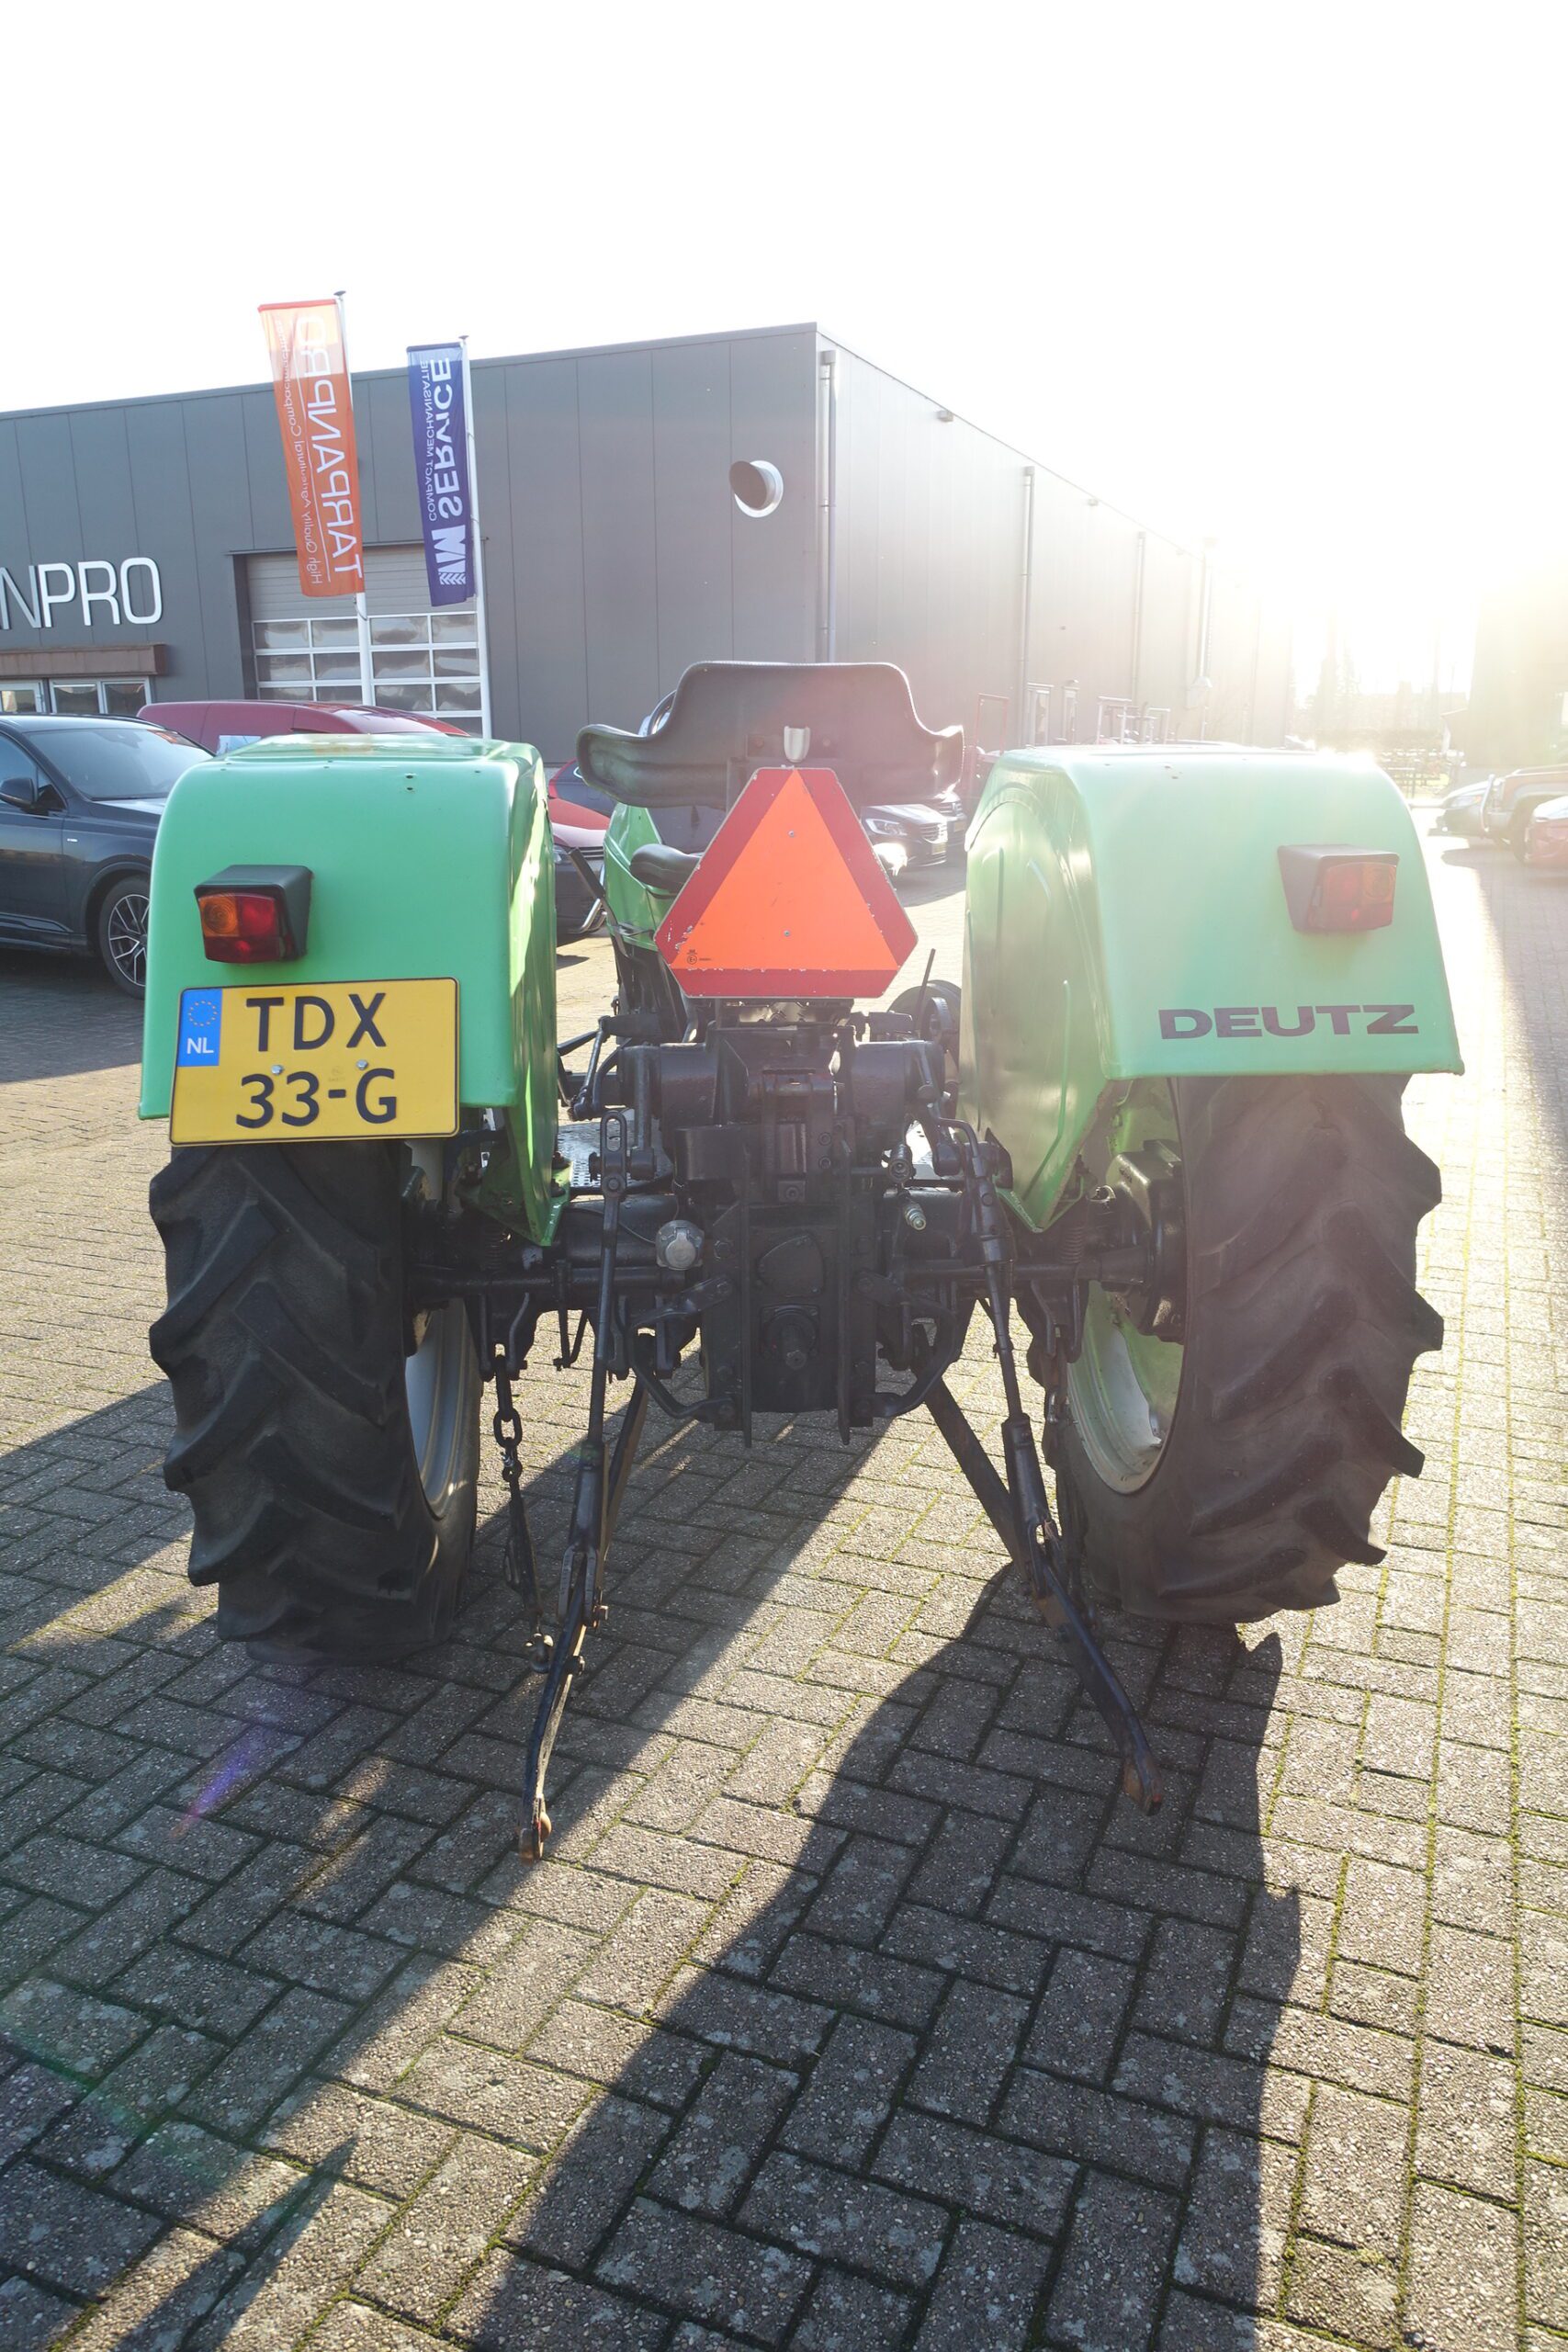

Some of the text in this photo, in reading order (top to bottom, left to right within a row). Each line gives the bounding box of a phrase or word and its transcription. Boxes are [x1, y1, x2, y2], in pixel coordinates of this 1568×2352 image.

[186, 1037, 214, 1055] NL
[246, 992, 387, 1052] TDX
[1158, 1004, 1419, 1040] DEUTZ
[235, 1068, 397, 1129] 33-G
